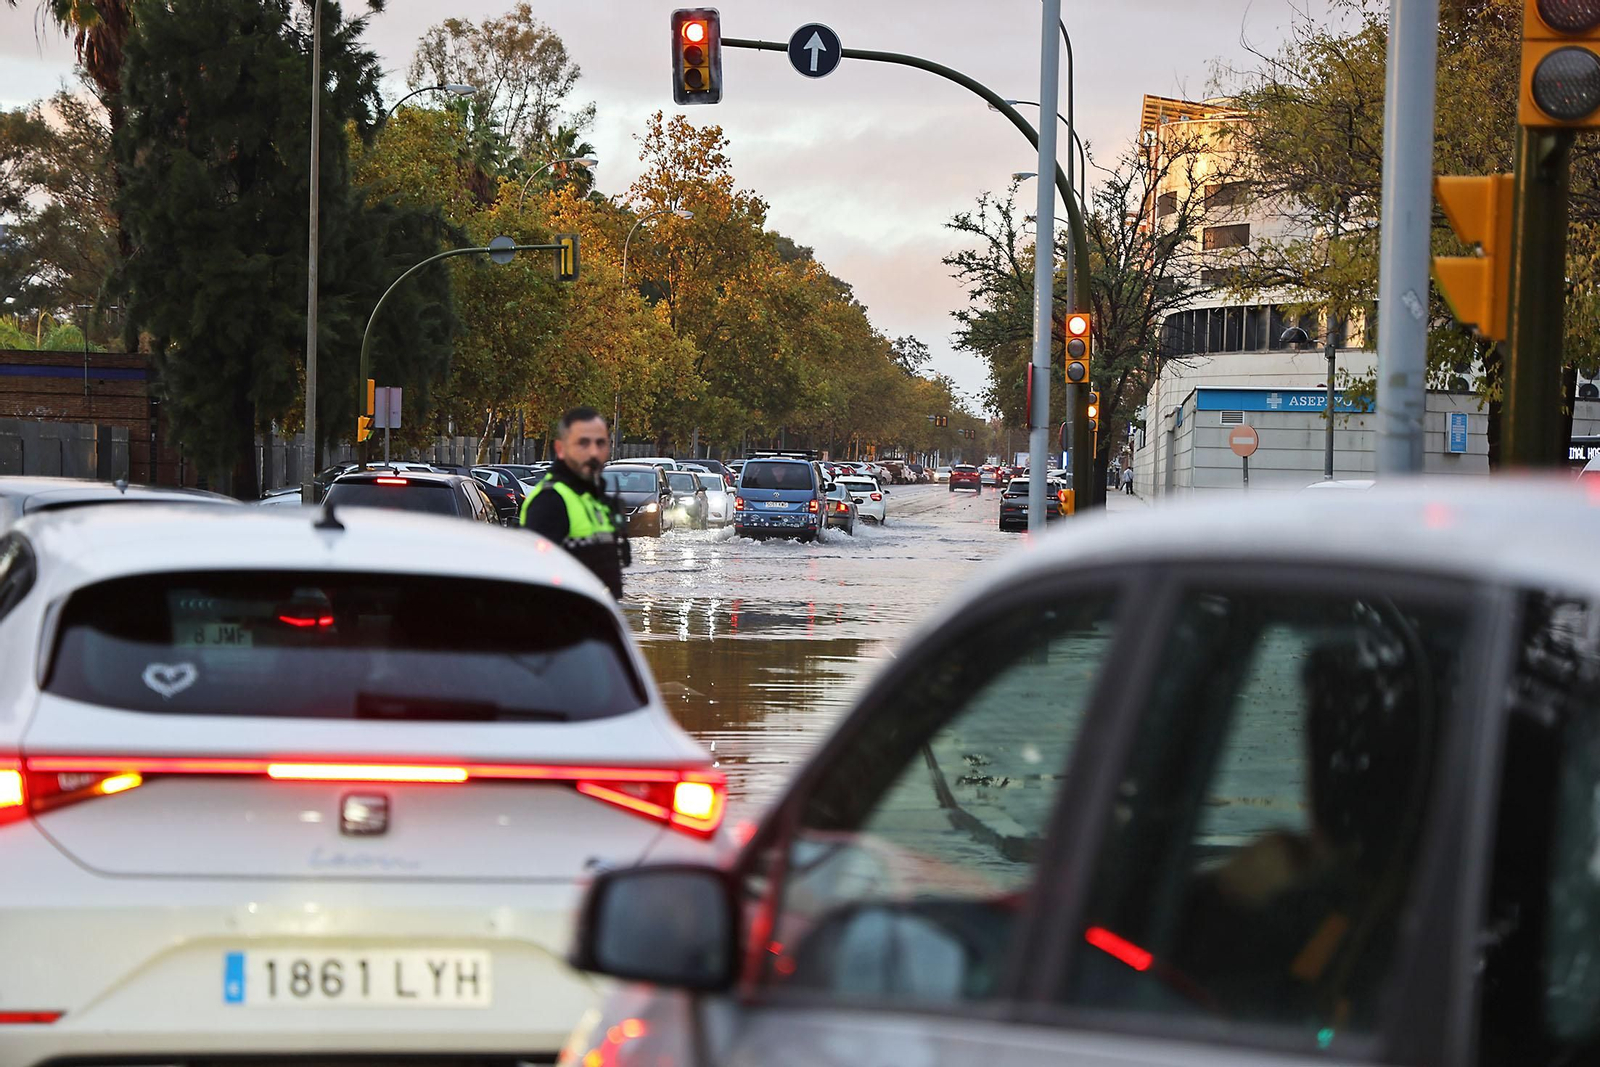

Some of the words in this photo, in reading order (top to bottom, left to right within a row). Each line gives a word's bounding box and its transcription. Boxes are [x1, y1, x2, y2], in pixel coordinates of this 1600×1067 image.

[1289, 395, 1353, 407] ASEPYO
[266, 959, 370, 998] 1861
[395, 959, 480, 997] LYH
